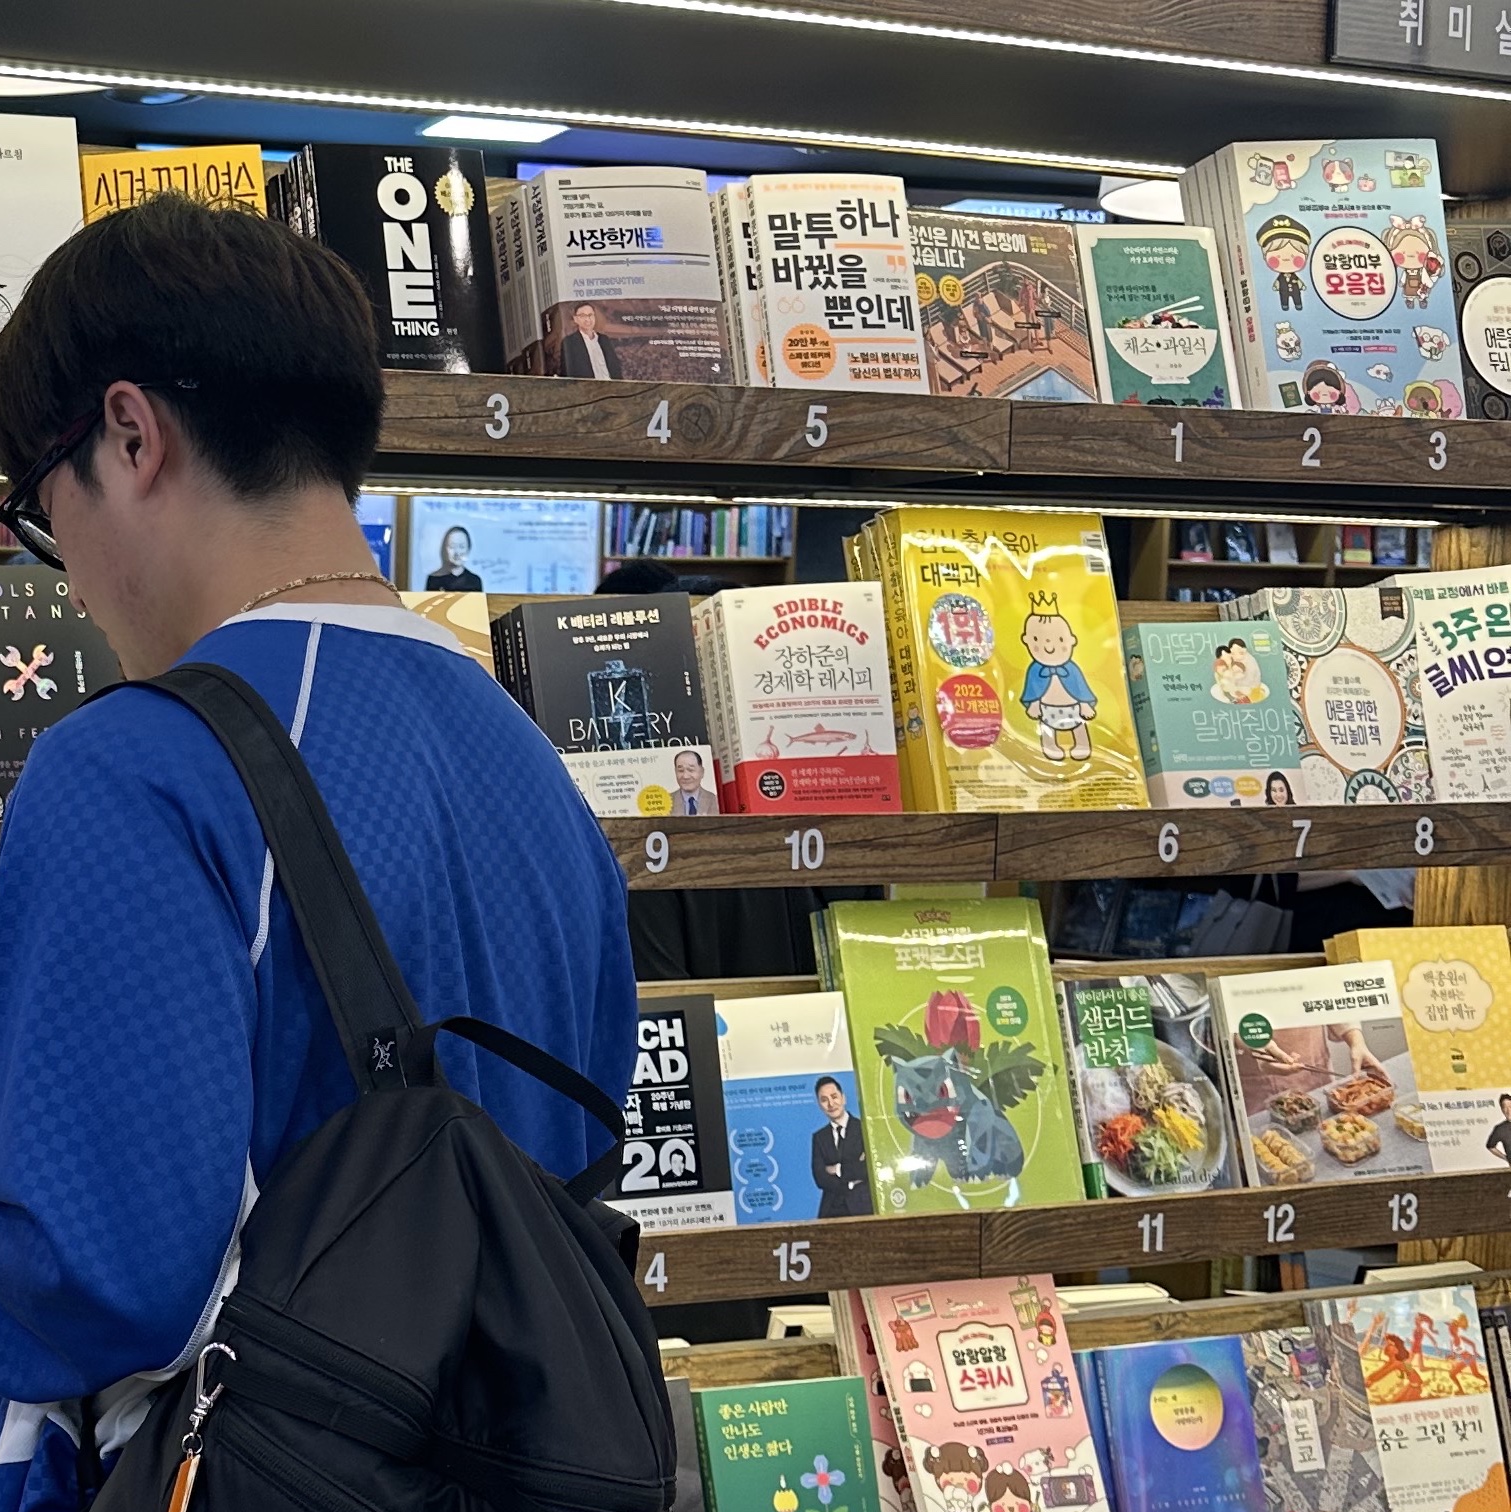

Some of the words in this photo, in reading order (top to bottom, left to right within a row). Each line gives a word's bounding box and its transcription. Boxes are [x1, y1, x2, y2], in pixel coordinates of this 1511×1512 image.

[384, 156, 414, 173] THE
[566, 226, 665, 250] 사장학개론
[767, 210, 837, 252] 말투
[835, 197, 901, 239] 하나
[376, 173, 438, 320] ONE
[771, 252, 868, 292] 바꿨을
[1325, 272, 1386, 296] 모음집
[392, 321, 440, 337] THING
[824, 294, 915, 331] 뿐인데
[485, 392, 511, 439] 3
[647, 400, 672, 444] 4
[804, 405, 829, 448] 5
[1170, 422, 1184, 463] 1
[1301, 427, 1322, 467] 2
[1428, 431, 1447, 471] 3
[920, 562, 982, 588] 대백과
[557, 616, 569, 630] K
[570, 613, 608, 629] 배터리
[609, 608, 661, 627] 레볼루션
[773, 597, 844, 619] EDIBLE
[753, 614, 870, 651] ECONOMICS
[775, 645, 849, 670] 장하준의
[754, 669, 814, 695] 경제학
[817, 667, 873, 691] 레시피
[953, 684, 982, 698] 2022
[569, 711, 674, 743] BATTERY
[1192, 708, 1292, 743] 말해줘야
[645, 831, 670, 873] 9
[784, 828, 825, 870] 10
[1158, 822, 1180, 863] 6
[1291, 819, 1312, 858] 7
[1414, 816, 1434, 856] 8
[1422, 969, 1468, 988] 백종원이
[770, 1021, 790, 1034] 나를
[1080, 1005, 1153, 1037] 샐러드
[1084, 1035, 1136, 1070] 반찬
[621, 1138, 696, 1193] 20
[1263, 1203, 1295, 1243] 12
[1388, 1192, 1419, 1232] 13
[1138, 1212, 1165, 1253] 11
[772, 1241, 811, 1282] 15
[959, 1365, 1014, 1392] 스퀴시
[718, 1403, 747, 1419] 좋은
[748, 1398, 788, 1418] 사람만
[721, 1423, 763, 1440] 만나도
[1378, 1427, 1409, 1452] 숨은
[1415, 1424, 1446, 1445] 그림
[1454, 1419, 1484, 1443] 찾기
[723, 1444, 764, 1461] 인생은
